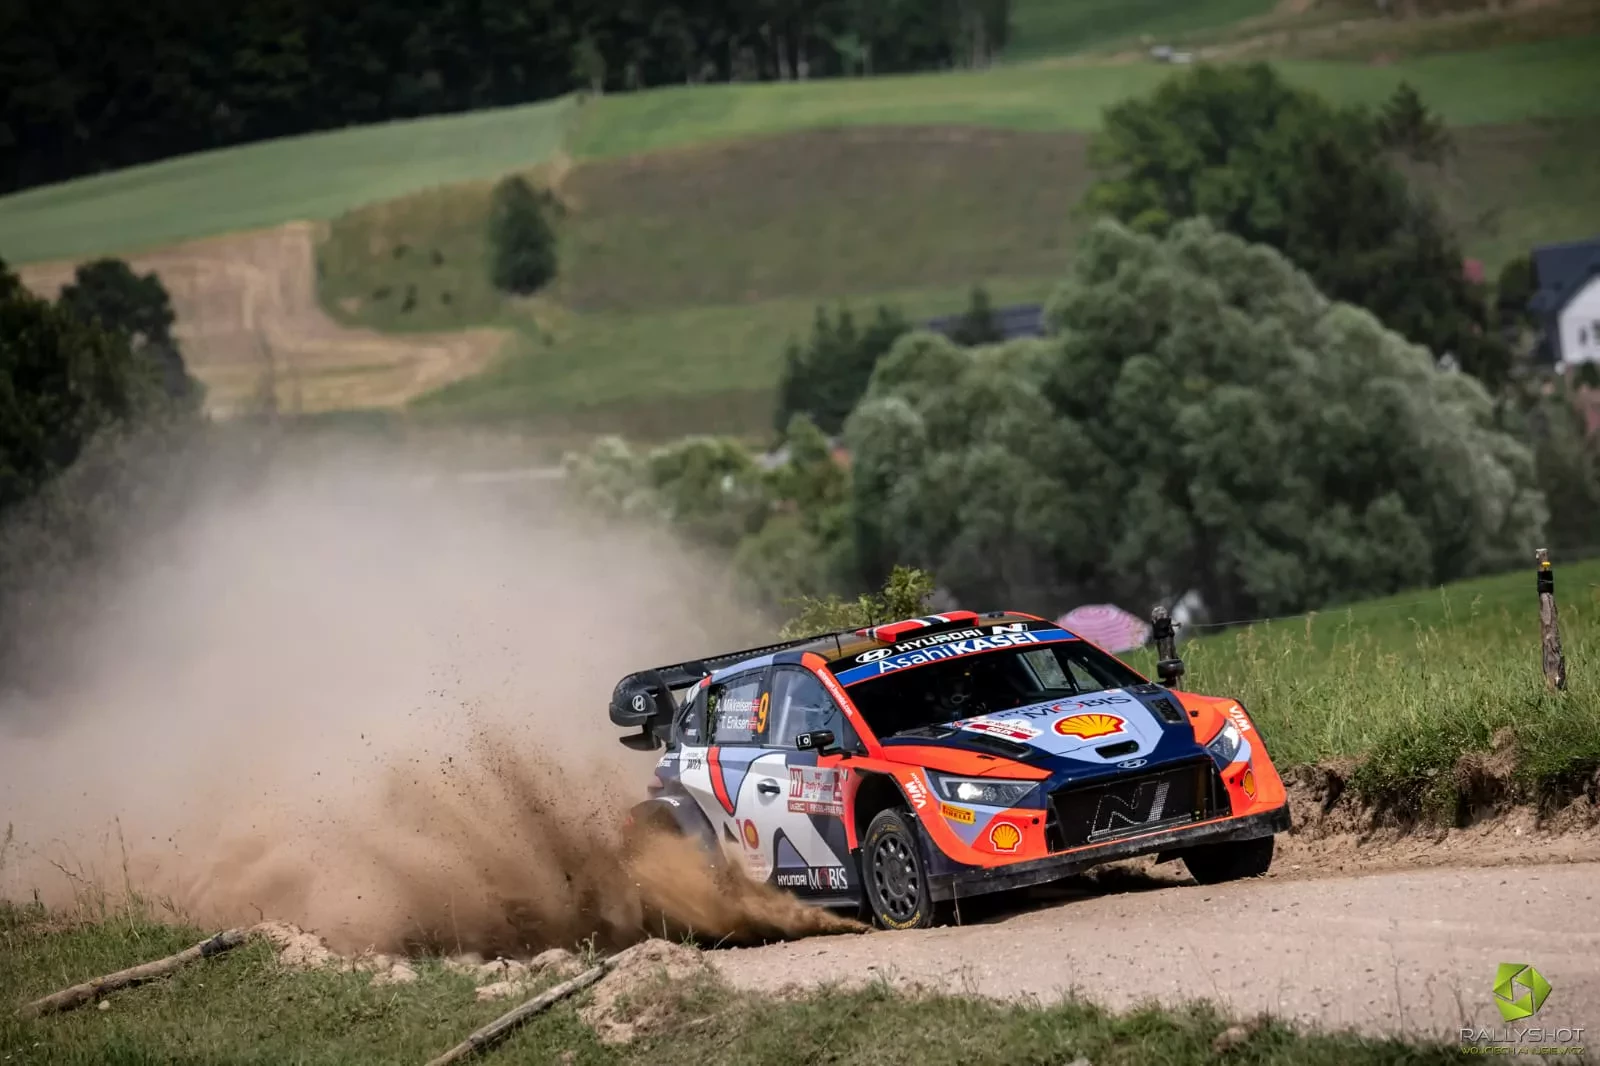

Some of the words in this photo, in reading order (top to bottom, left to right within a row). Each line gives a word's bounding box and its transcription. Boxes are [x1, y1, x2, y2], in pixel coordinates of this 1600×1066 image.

[895, 629, 985, 652] HYUNDAI
[878, 631, 1040, 674] AsahiKASEI
[723, 698, 752, 712] Mikkelsen
[757, 692, 769, 734] 9
[1023, 696, 1132, 719] MOBIS
[727, 716, 750, 729] Eriksen
[942, 804, 972, 821] PIRELLI
[777, 874, 808, 886] HYUNDAI
[808, 867, 848, 890] MOBIS
